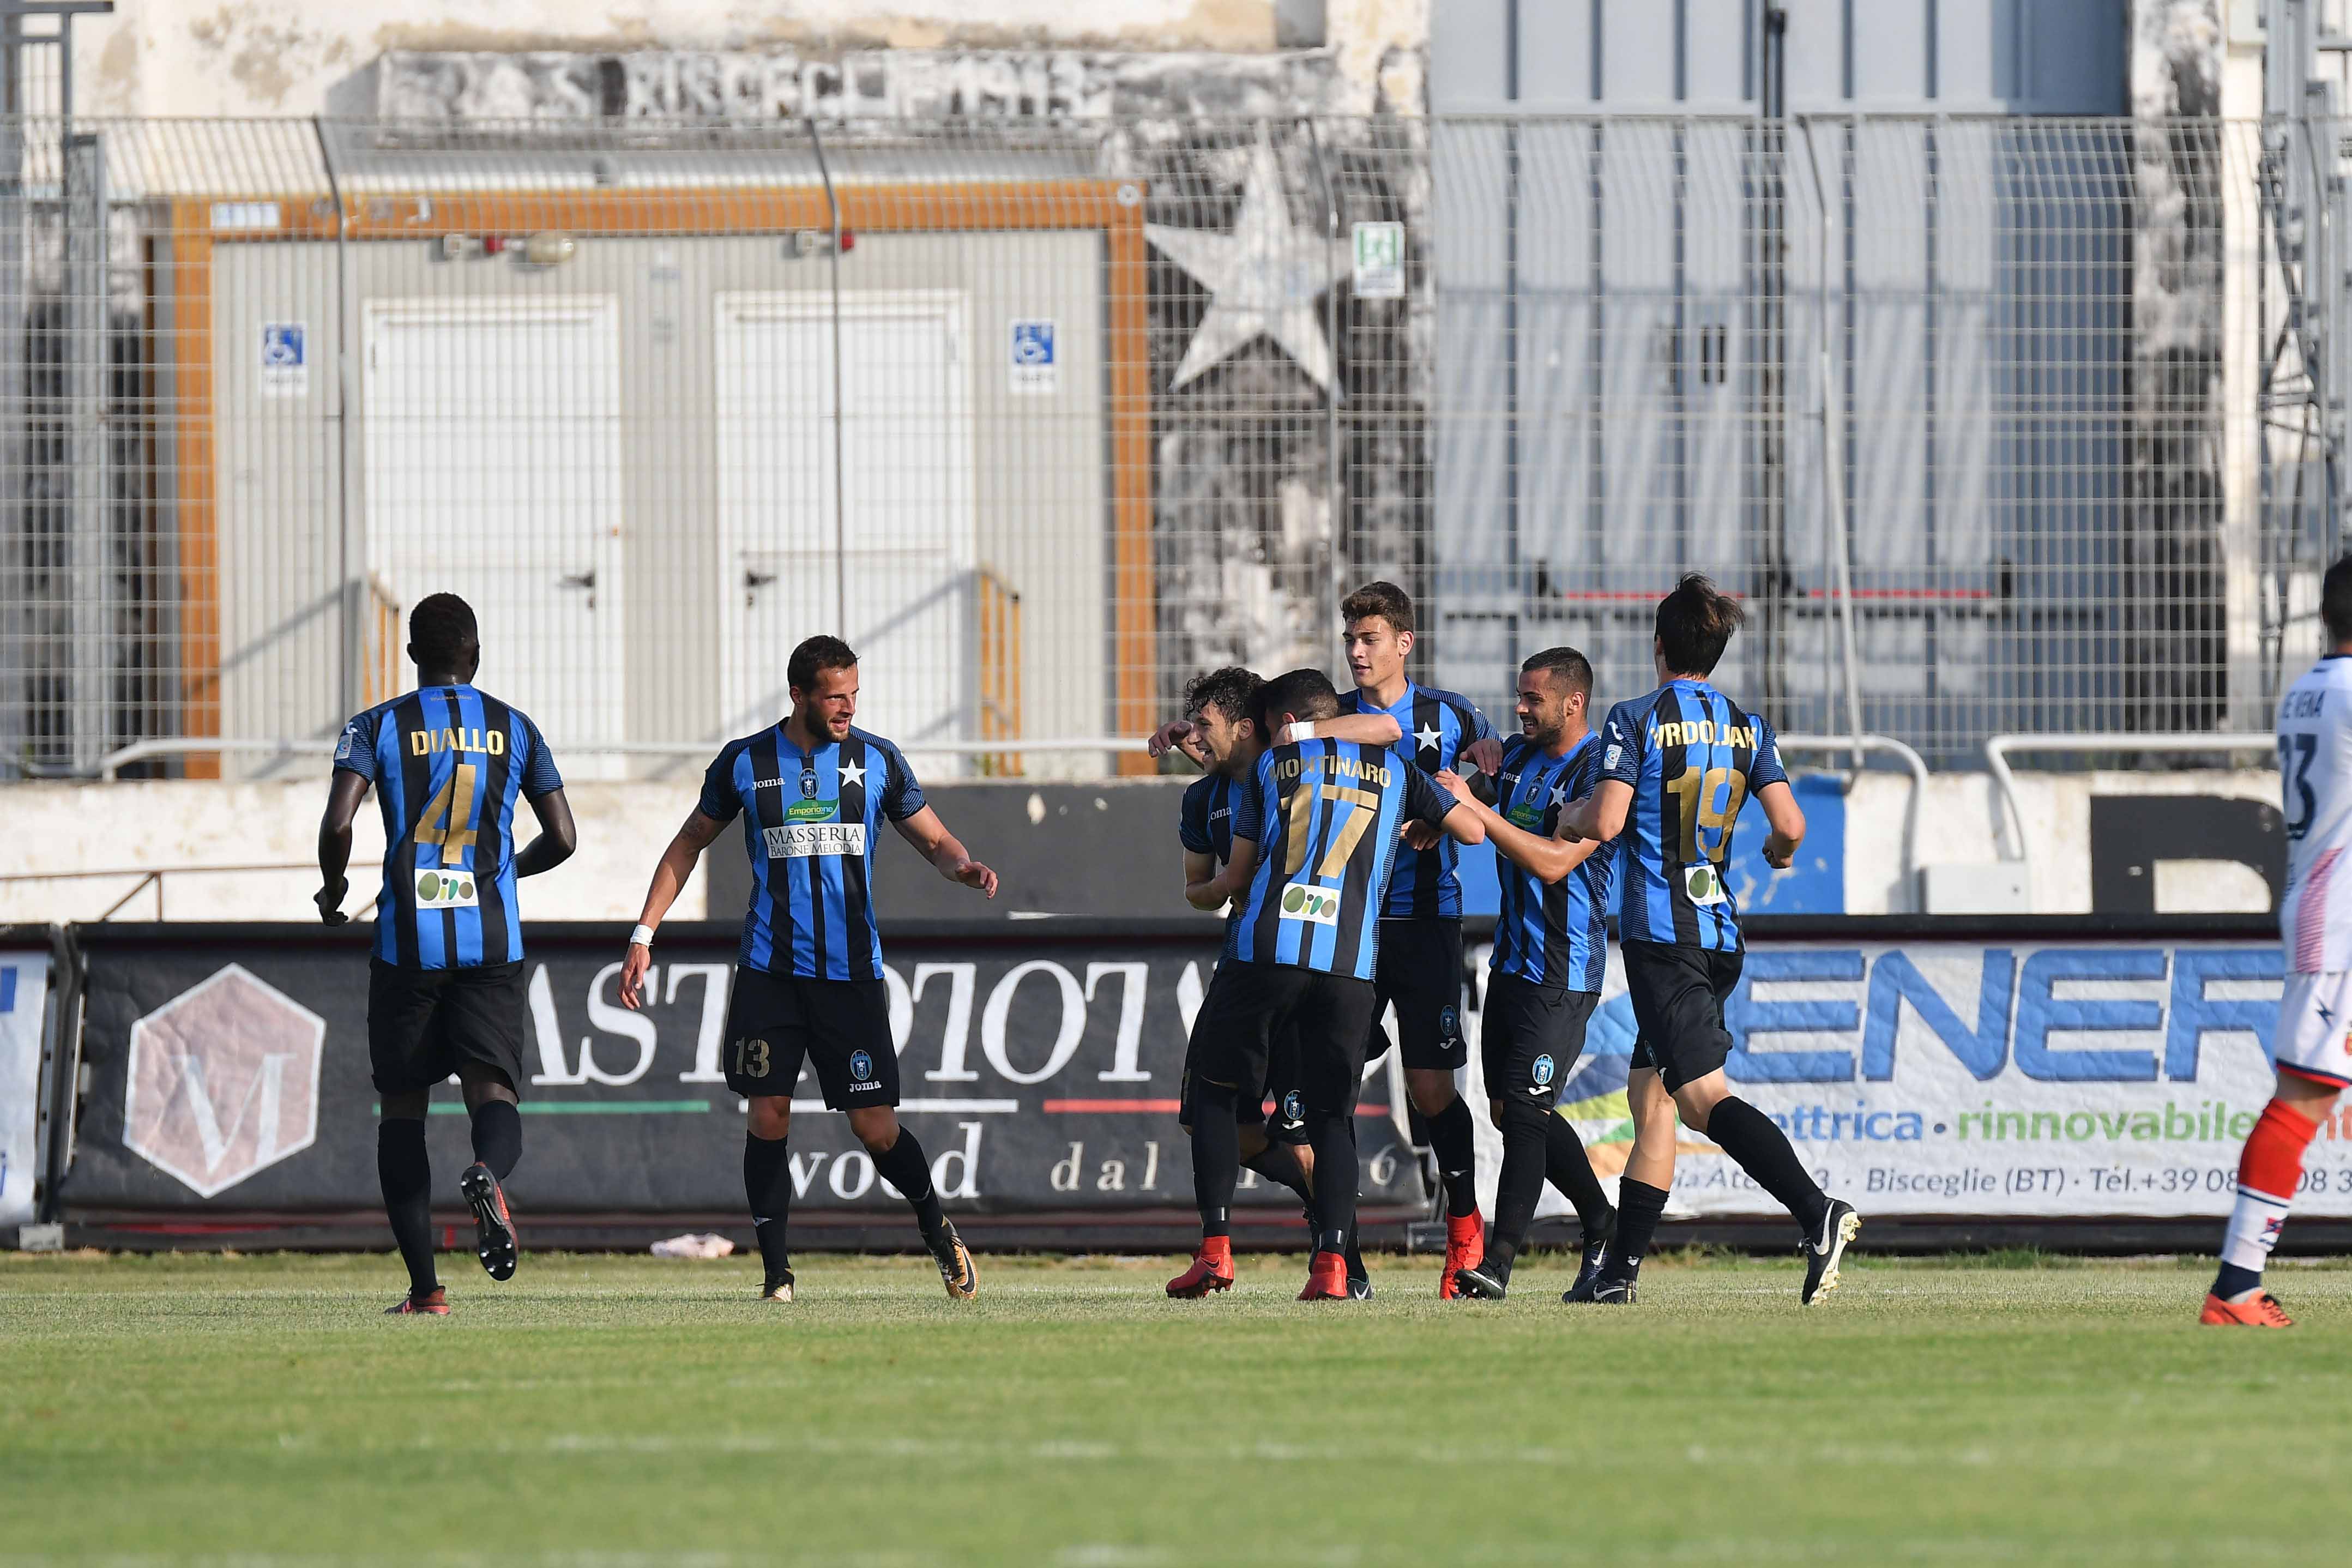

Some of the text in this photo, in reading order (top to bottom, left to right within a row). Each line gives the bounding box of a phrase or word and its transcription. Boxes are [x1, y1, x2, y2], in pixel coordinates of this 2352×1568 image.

[411, 727, 504, 756] DIALLO
[1269, 755, 1391, 788] MONTINARO
[414, 763, 478, 864] 4
[1280, 783, 1379, 879] 17
[1667, 765, 1746, 863] 19
[768, 827, 861, 845] MASSERIA
[770, 842, 862, 857] BARONE MELODIA
[735, 1036, 770, 1078] 13
[1050, 1141, 1159, 1191] dal
[1867, 1167, 1997, 1198] Bisceglie
[2005, 1167, 2066, 1197] (BT)
